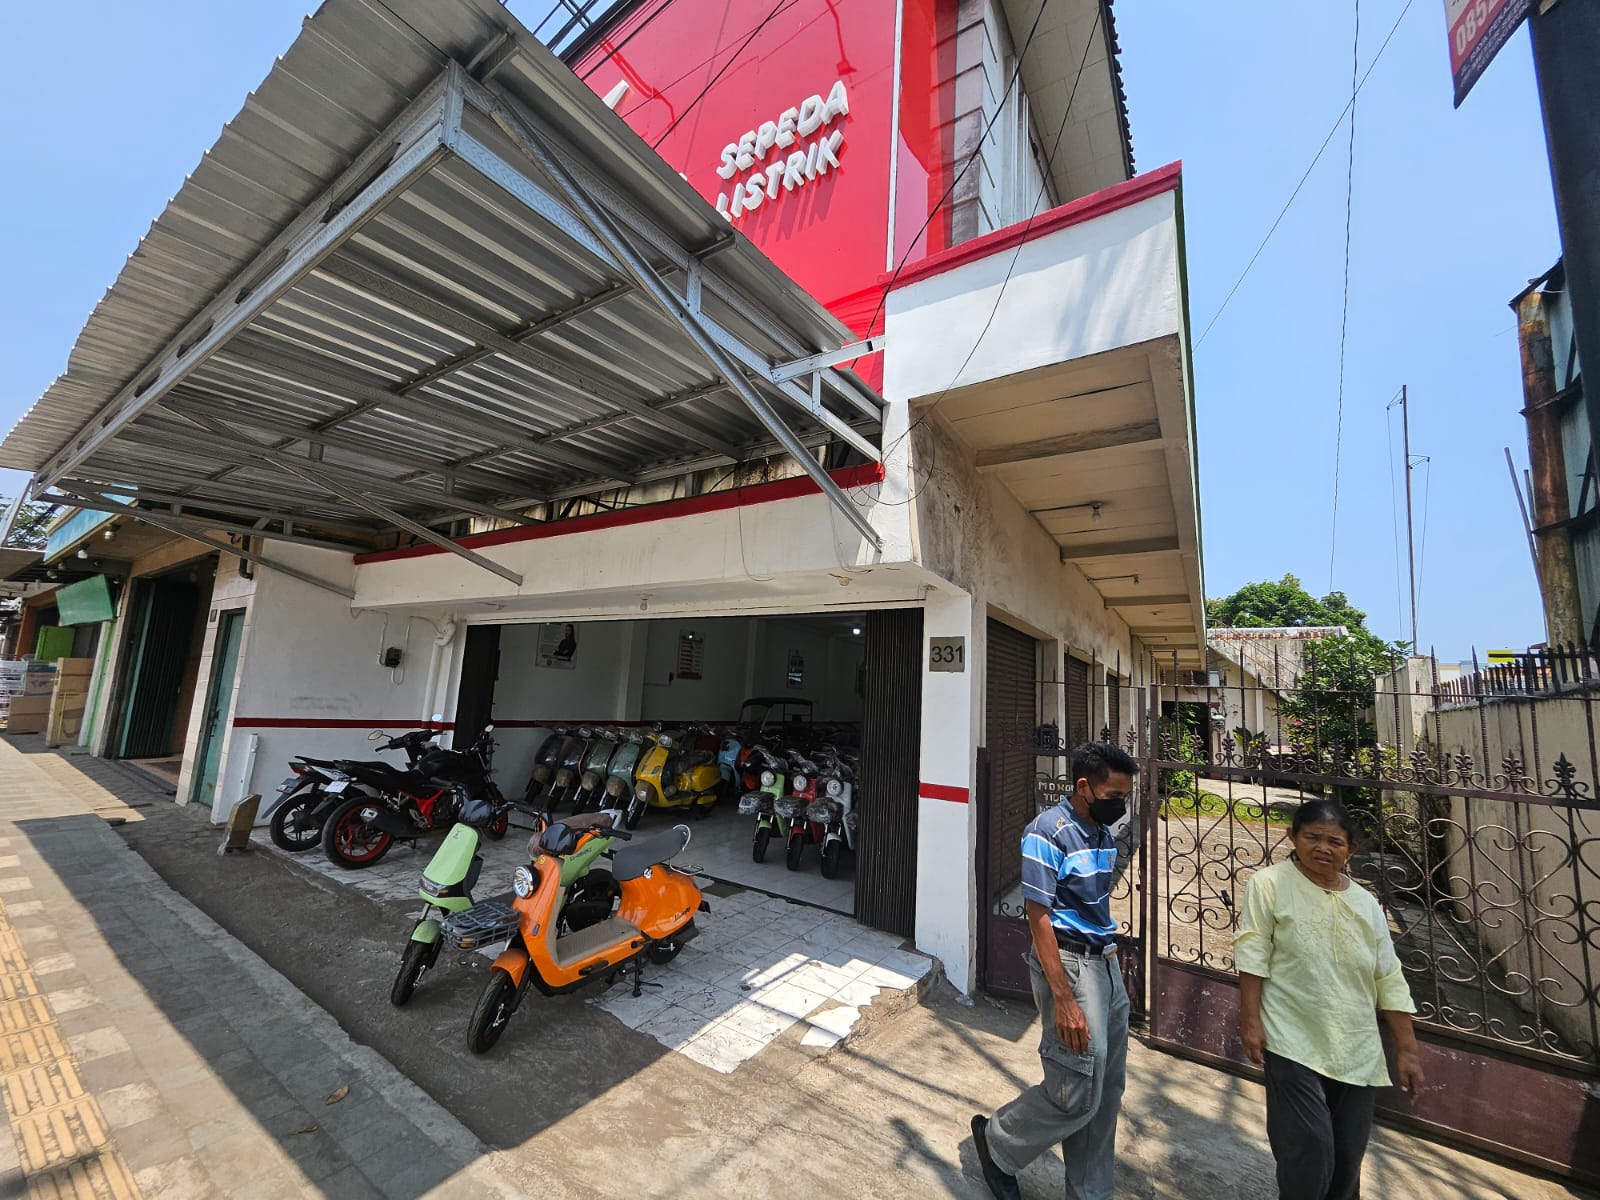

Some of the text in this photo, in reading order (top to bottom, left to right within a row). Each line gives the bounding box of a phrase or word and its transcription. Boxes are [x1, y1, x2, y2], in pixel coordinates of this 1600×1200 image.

[716, 80, 849, 180] SEPEDA
[716, 129, 845, 223] LISTRIK
[931, 645, 963, 663] 331
